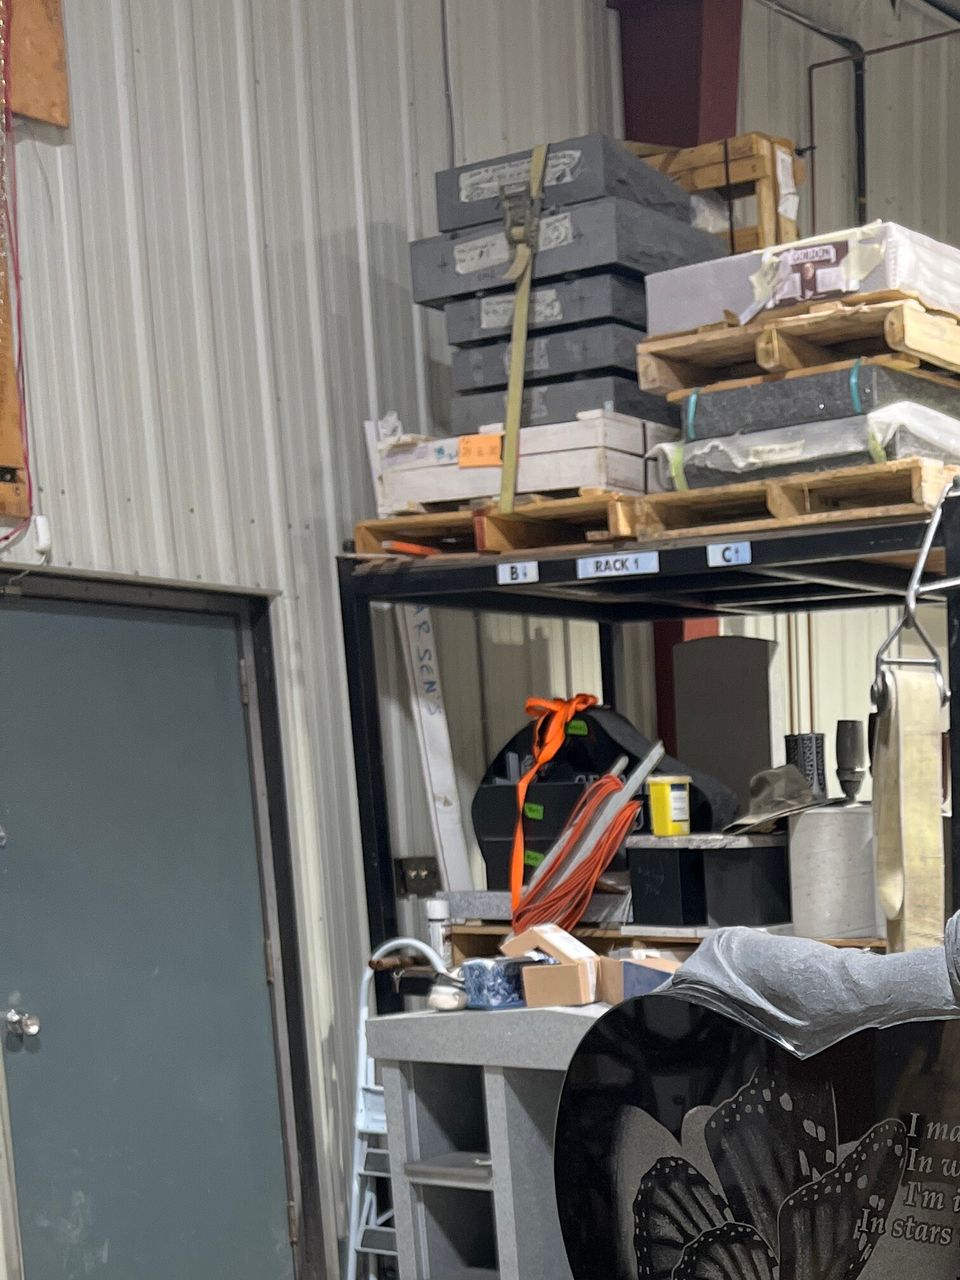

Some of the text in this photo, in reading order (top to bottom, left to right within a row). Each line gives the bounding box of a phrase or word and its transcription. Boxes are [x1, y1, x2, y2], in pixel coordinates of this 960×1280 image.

[594, 560, 629, 573] RACK
[722, 548, 732, 563] C
[510, 567, 518, 580] B
[908, 1113, 920, 1137] I
[907, 1148, 933, 1172] In
[904, 1181, 945, 1210] I'm
[860, 1209, 887, 1234] In
[893, 1216, 951, 1245] stars
